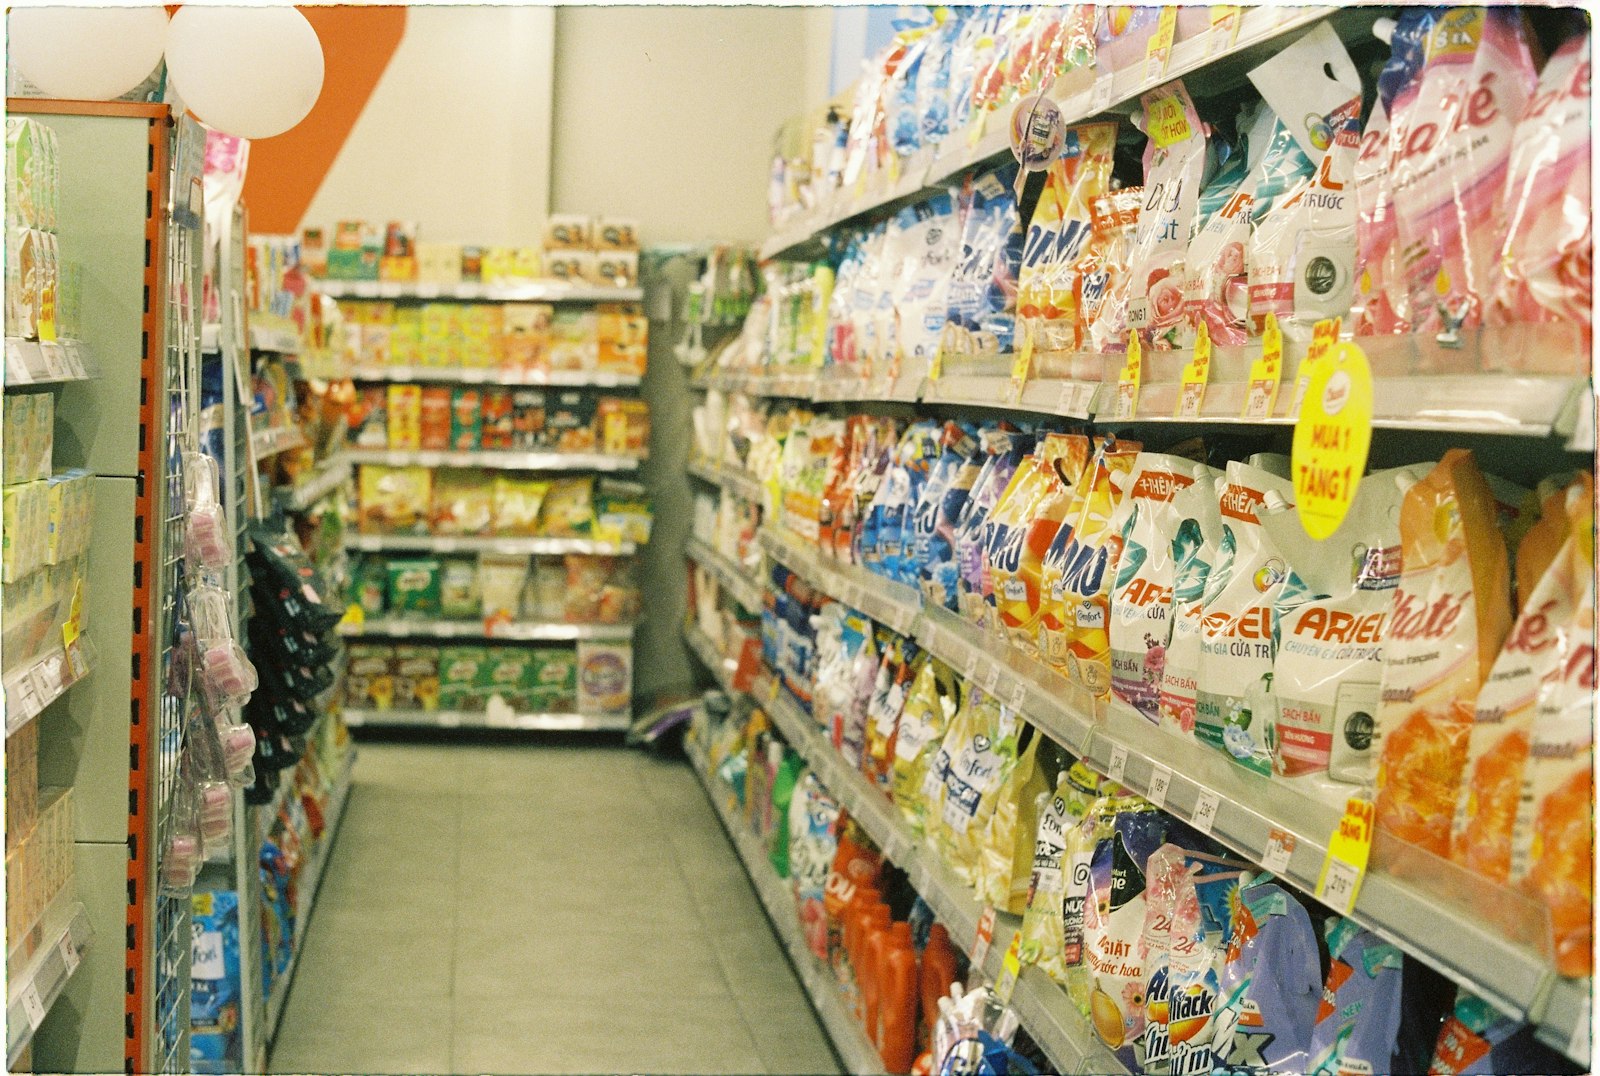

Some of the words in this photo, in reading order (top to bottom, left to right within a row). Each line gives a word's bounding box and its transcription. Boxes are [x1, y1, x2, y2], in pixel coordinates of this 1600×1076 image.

[1312, 425, 1341, 450] MUA
[1343, 426, 1351, 451] 1
[1300, 458, 1340, 506] TẶNG
[1342, 464, 1352, 502] 1
[1077, 610, 1102, 622] Comfort
[1147, 604, 1166, 620] CỬA
[1293, 607, 1387, 644] ARIEL
[1230, 639, 1251, 657] CỬA
[1152, 914, 1172, 933] 24
[1173, 936, 1198, 954] 24
[1119, 962, 1143, 977] hoa
